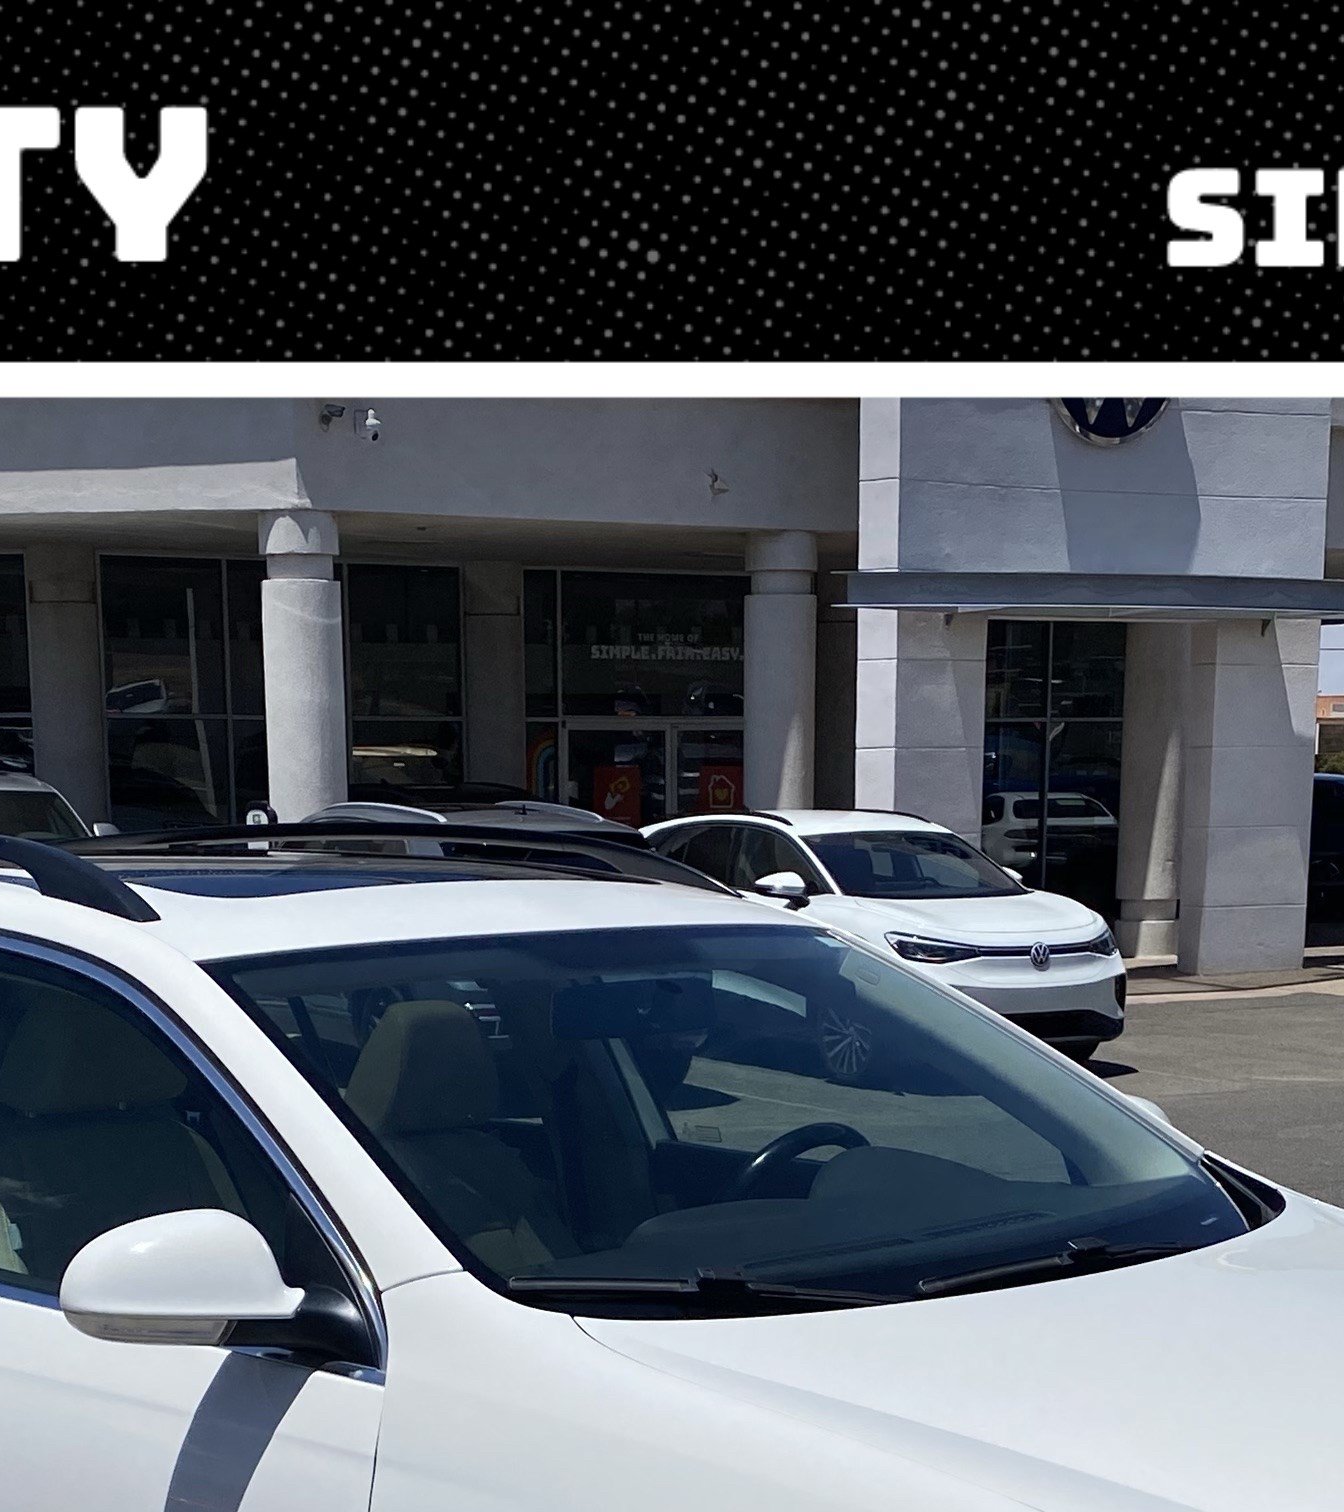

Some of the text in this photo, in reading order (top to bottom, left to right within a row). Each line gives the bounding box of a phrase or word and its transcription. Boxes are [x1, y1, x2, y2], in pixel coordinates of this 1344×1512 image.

[638, 633, 700, 642] THE HOME OF
